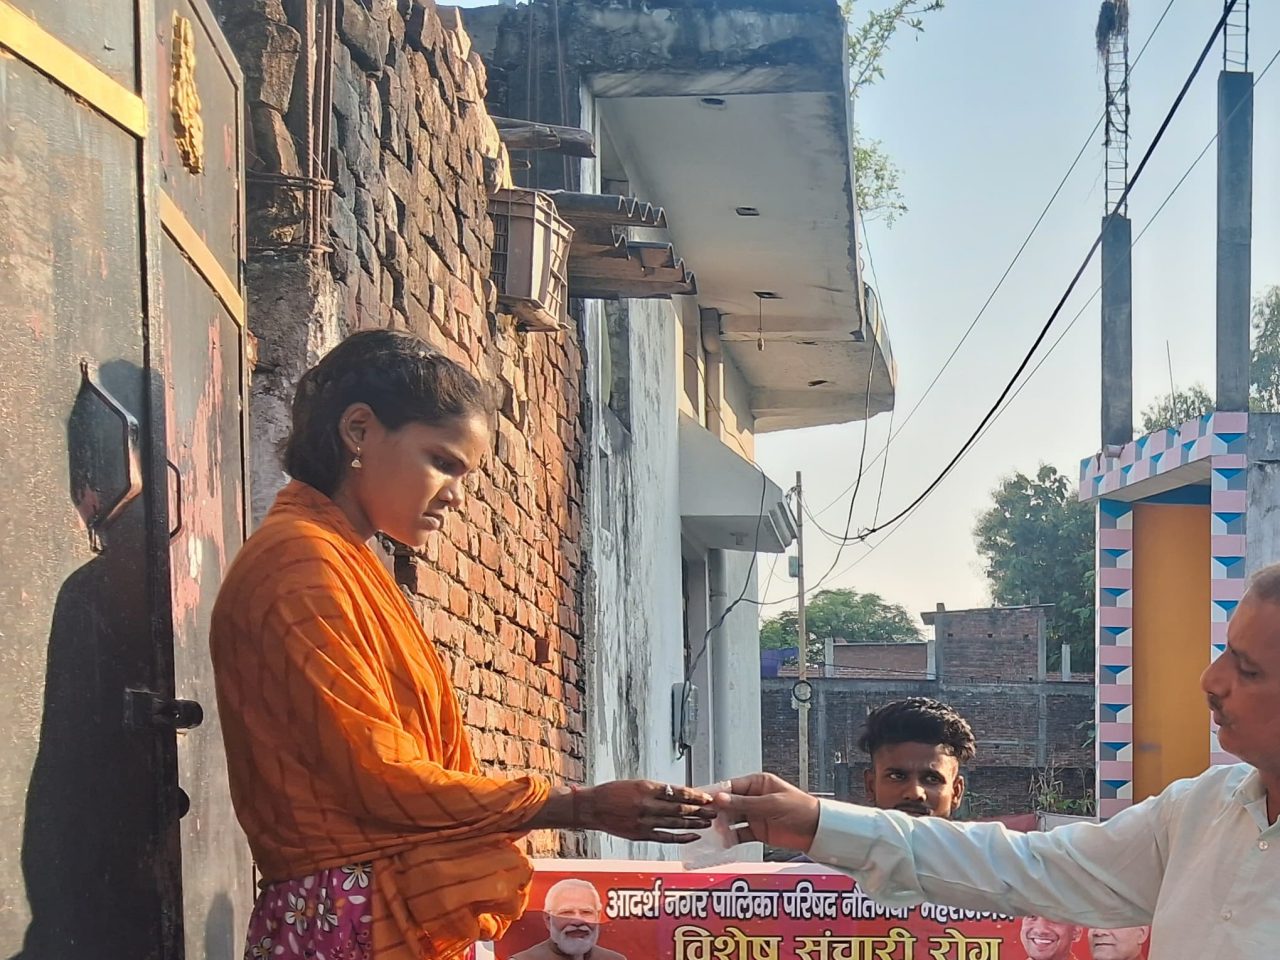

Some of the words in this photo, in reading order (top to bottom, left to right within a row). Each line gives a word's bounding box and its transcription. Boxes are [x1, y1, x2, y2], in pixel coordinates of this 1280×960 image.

[606, 879, 662, 919] आदर्श
[664, 890, 709, 918] नगर
[711, 879, 779, 920] पालिका
[783, 881, 837, 919] परिषद
